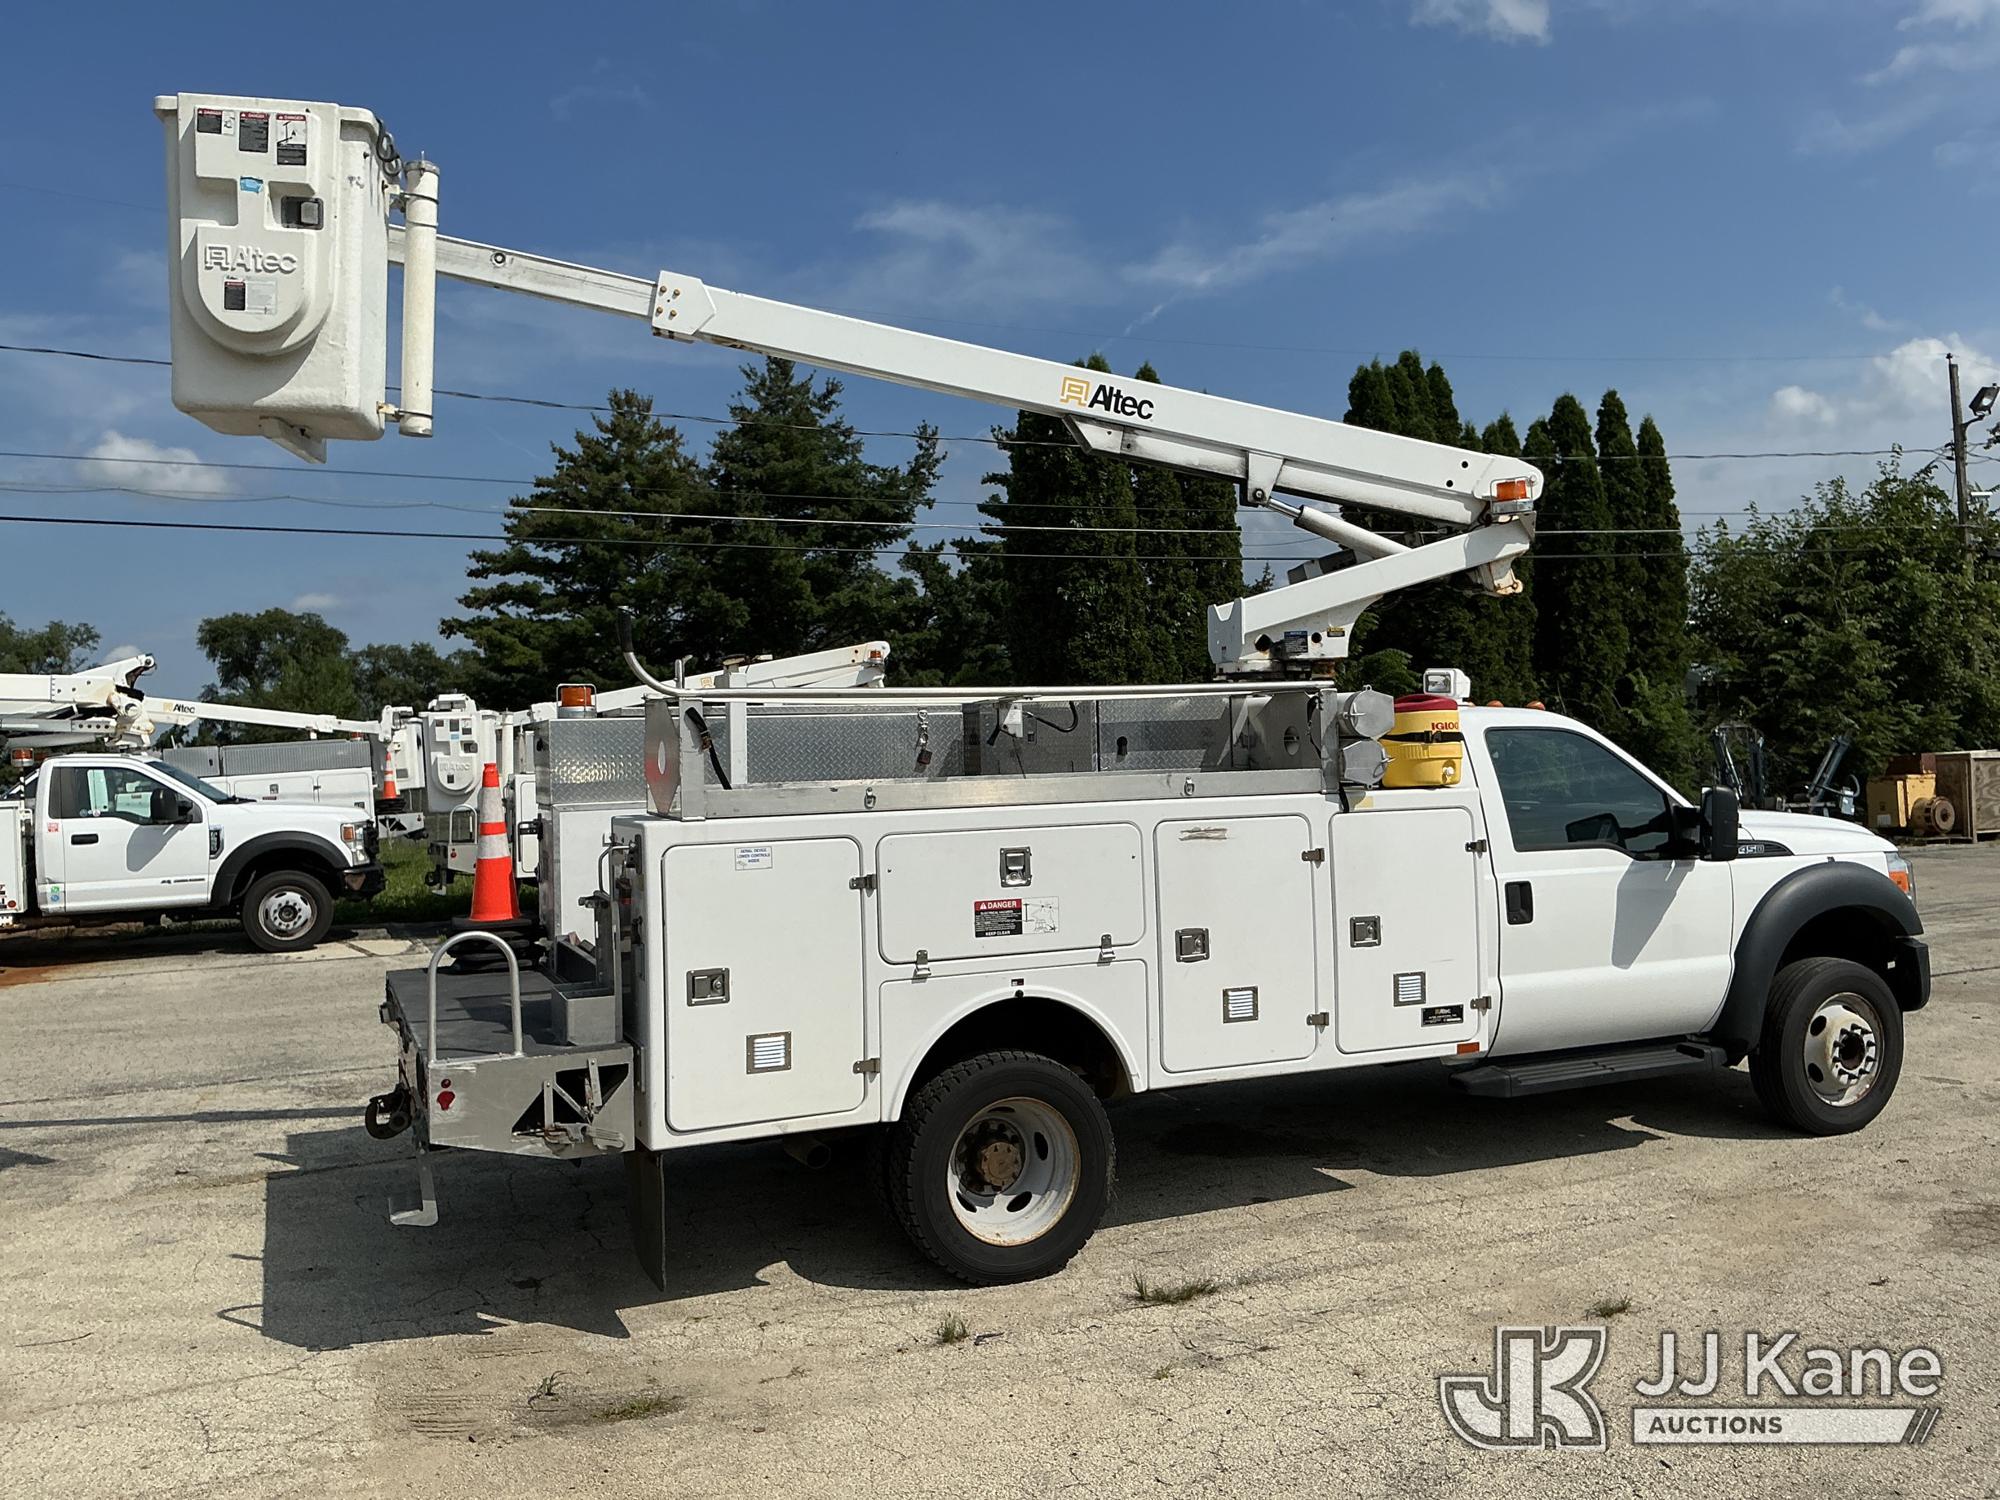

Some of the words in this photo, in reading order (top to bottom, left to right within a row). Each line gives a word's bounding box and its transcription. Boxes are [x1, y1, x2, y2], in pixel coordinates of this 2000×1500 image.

[230, 245, 298, 274] Altec
[1088, 384, 1155, 420] Altec
[173, 703, 196, 714] Altec
[987, 901, 1017, 909] DANGER
